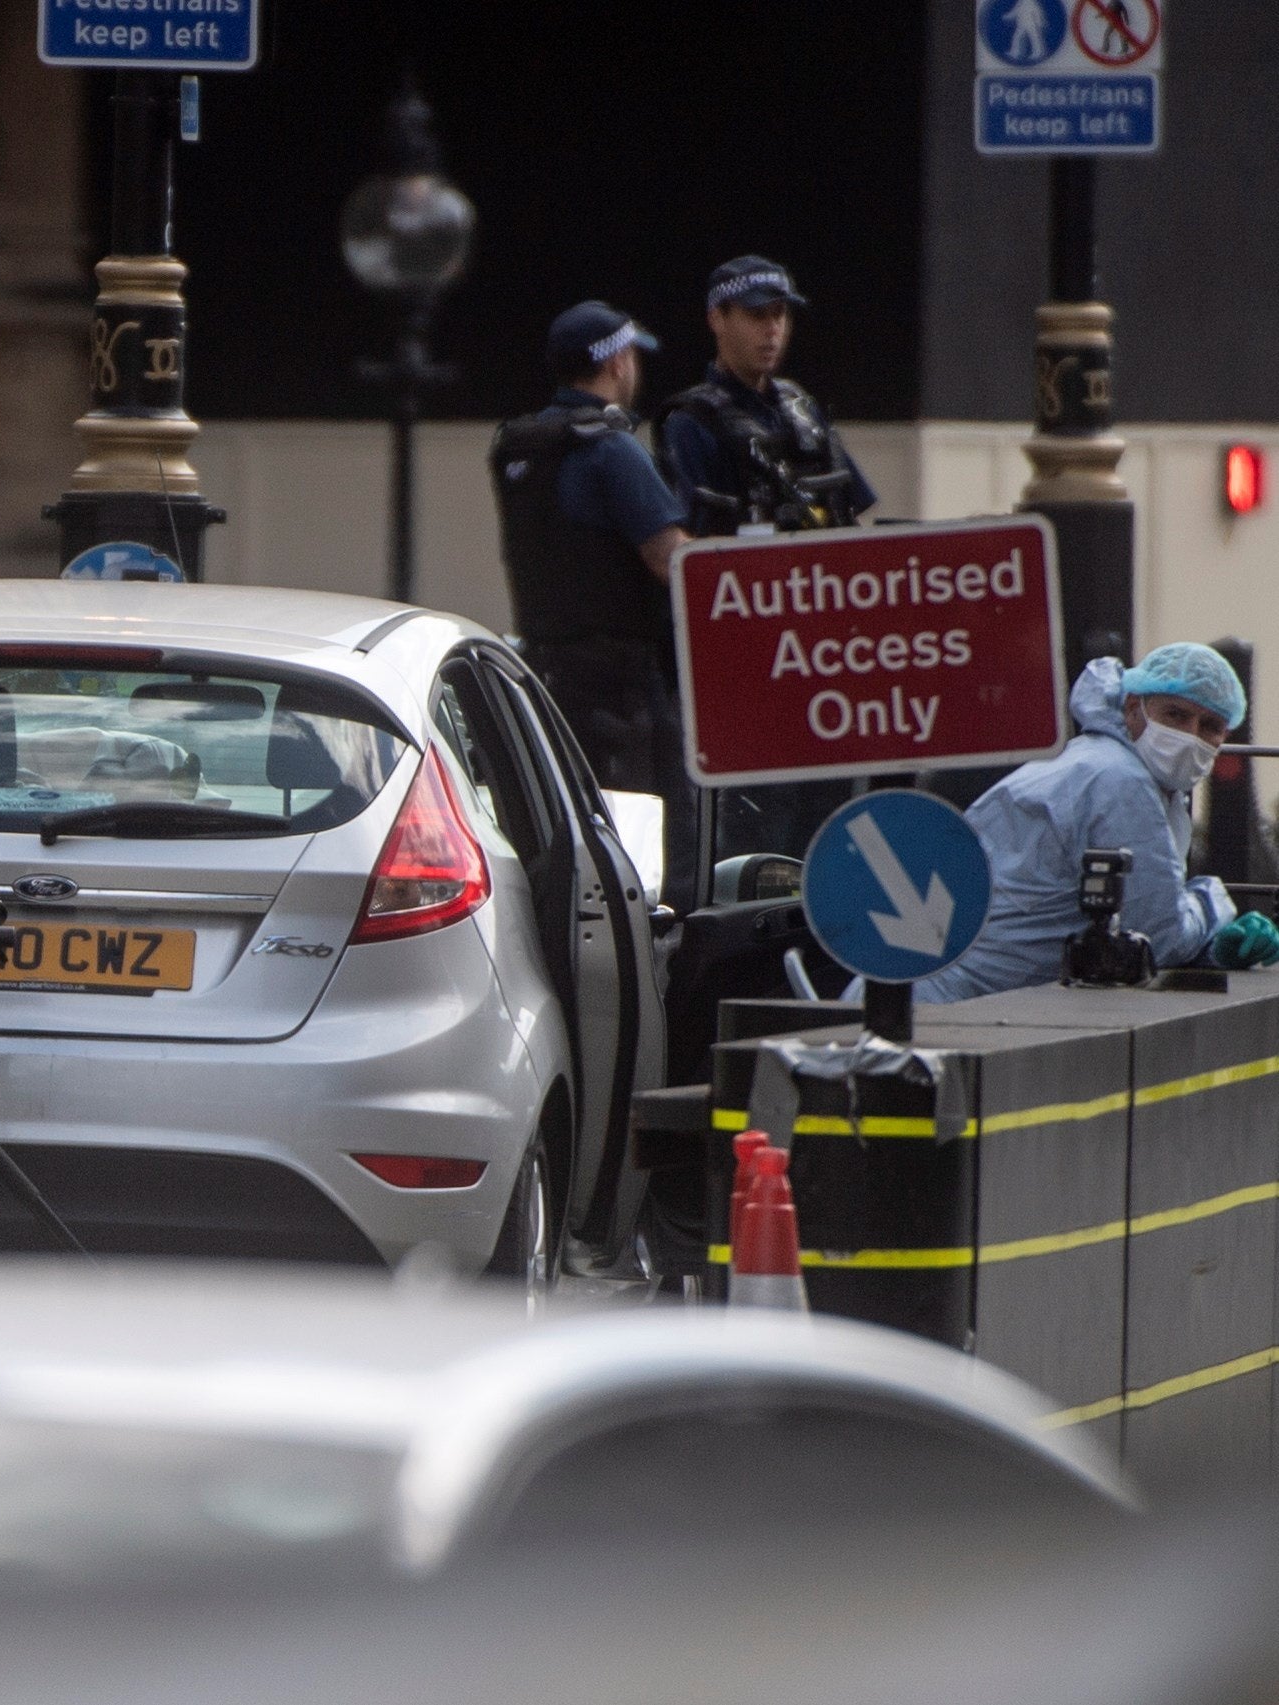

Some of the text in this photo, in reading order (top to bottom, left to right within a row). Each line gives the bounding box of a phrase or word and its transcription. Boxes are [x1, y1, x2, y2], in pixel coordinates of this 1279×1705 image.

[55, 0, 239, 12] eestrians
[75, 18, 219, 50] keep left
[988, 83, 1144, 106] Pedestrians
[1004, 112, 1129, 136] keep left
[709, 547, 1025, 620] Authorised
[769, 628, 972, 680] Access
[807, 685, 940, 743] Only
[59, 928, 164, 978] CWZ
